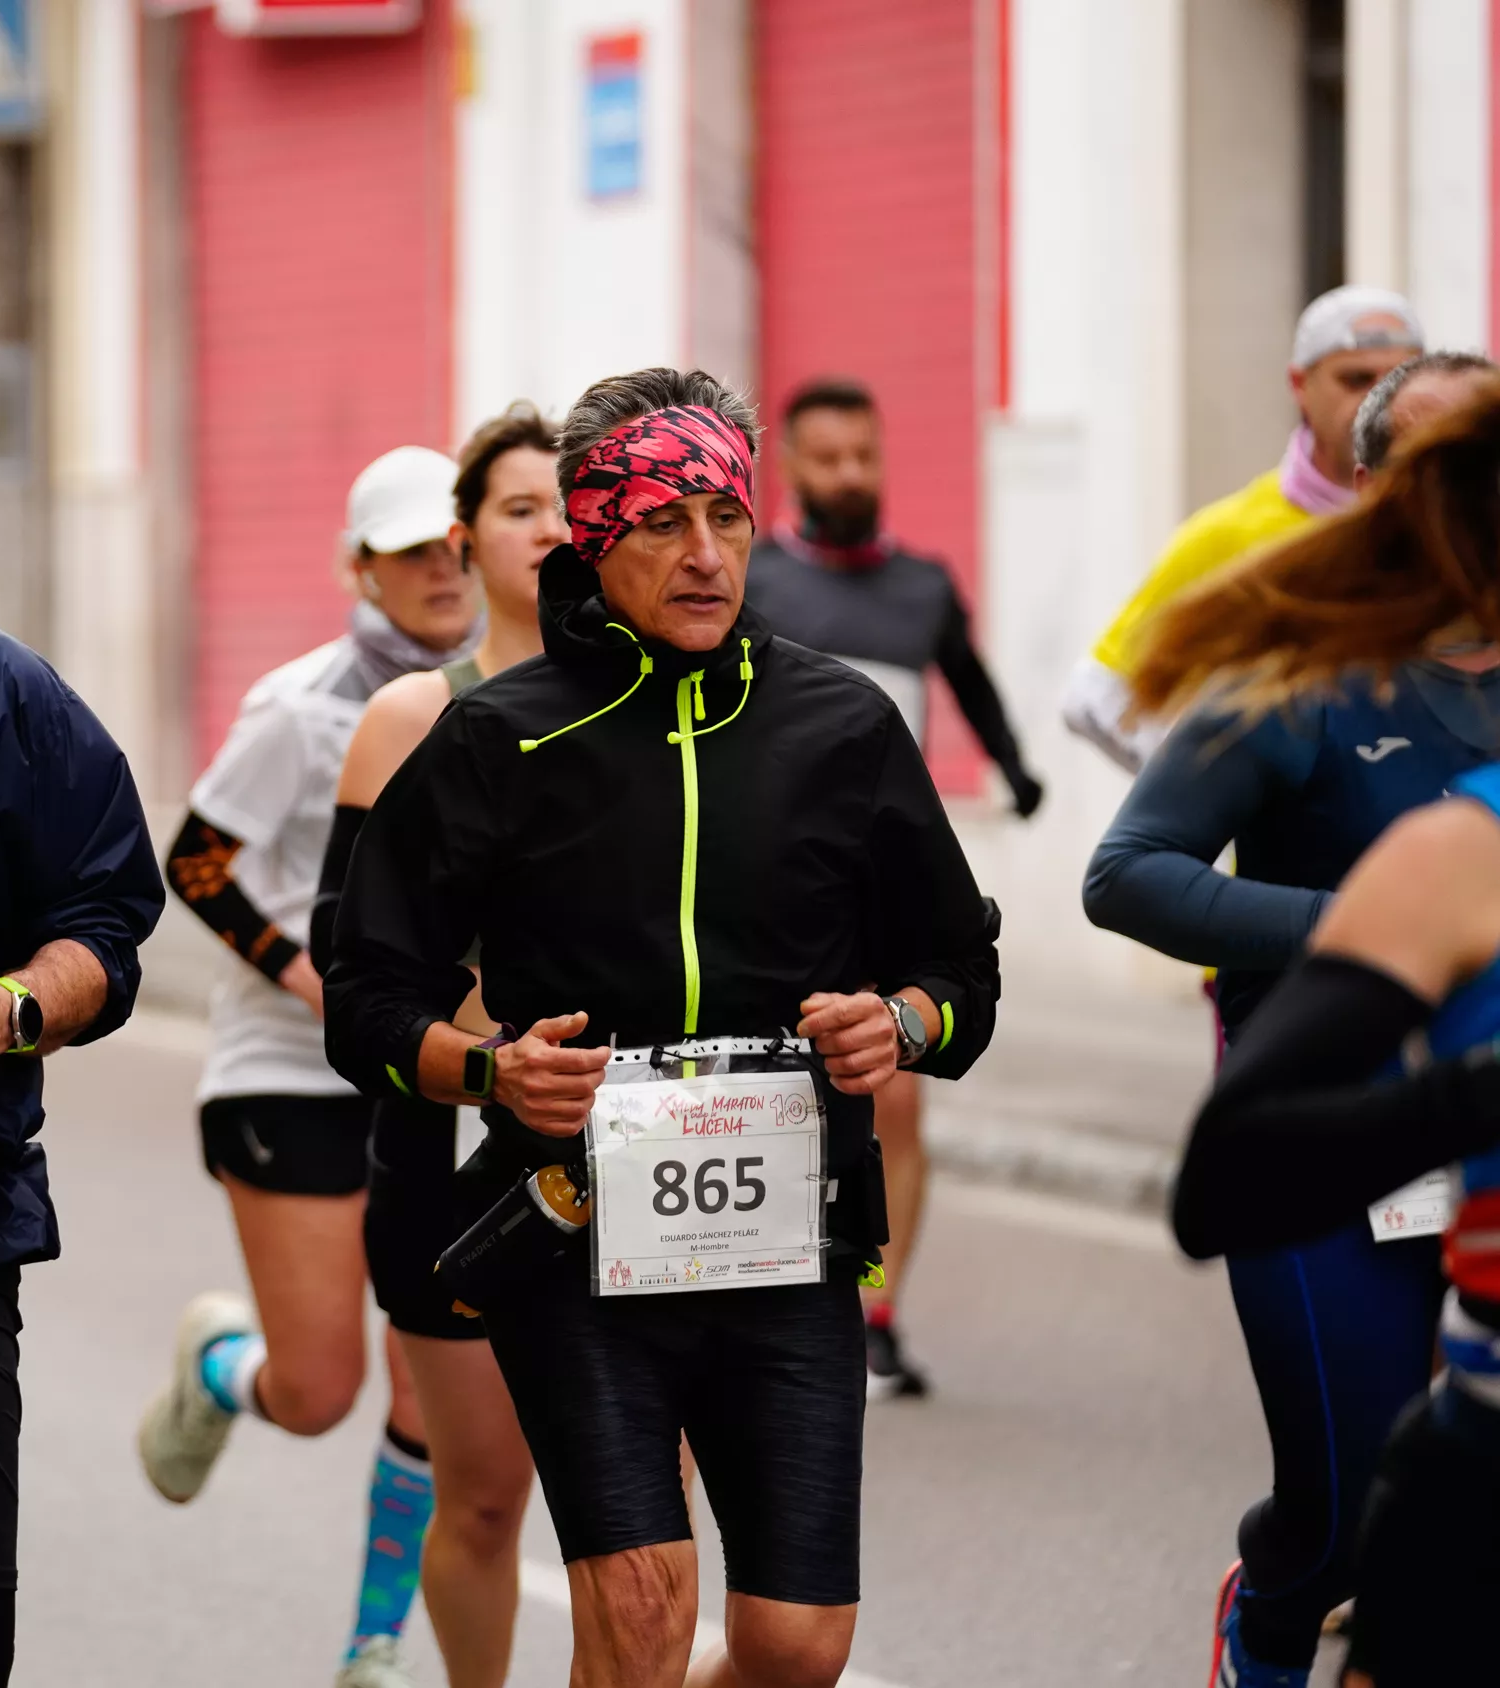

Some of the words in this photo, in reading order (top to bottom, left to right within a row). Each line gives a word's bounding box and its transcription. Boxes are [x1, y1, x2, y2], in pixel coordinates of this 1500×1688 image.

[712, 1095, 765, 1112] MARATÓN
[682, 1114, 754, 1136] LUCENA
[652, 1156, 766, 1216] 865
[660, 1233, 697, 1243] EDUARDO
[699, 1229, 732, 1240] SÁNCHEZ
[733, 1228, 759, 1238] PELÁEZ
[460, 1233, 497, 1268] EVADICT
[690, 1242, 729, 1252] M-Hombre
[738, 1258, 810, 1268] mediamaratonlucena.com
